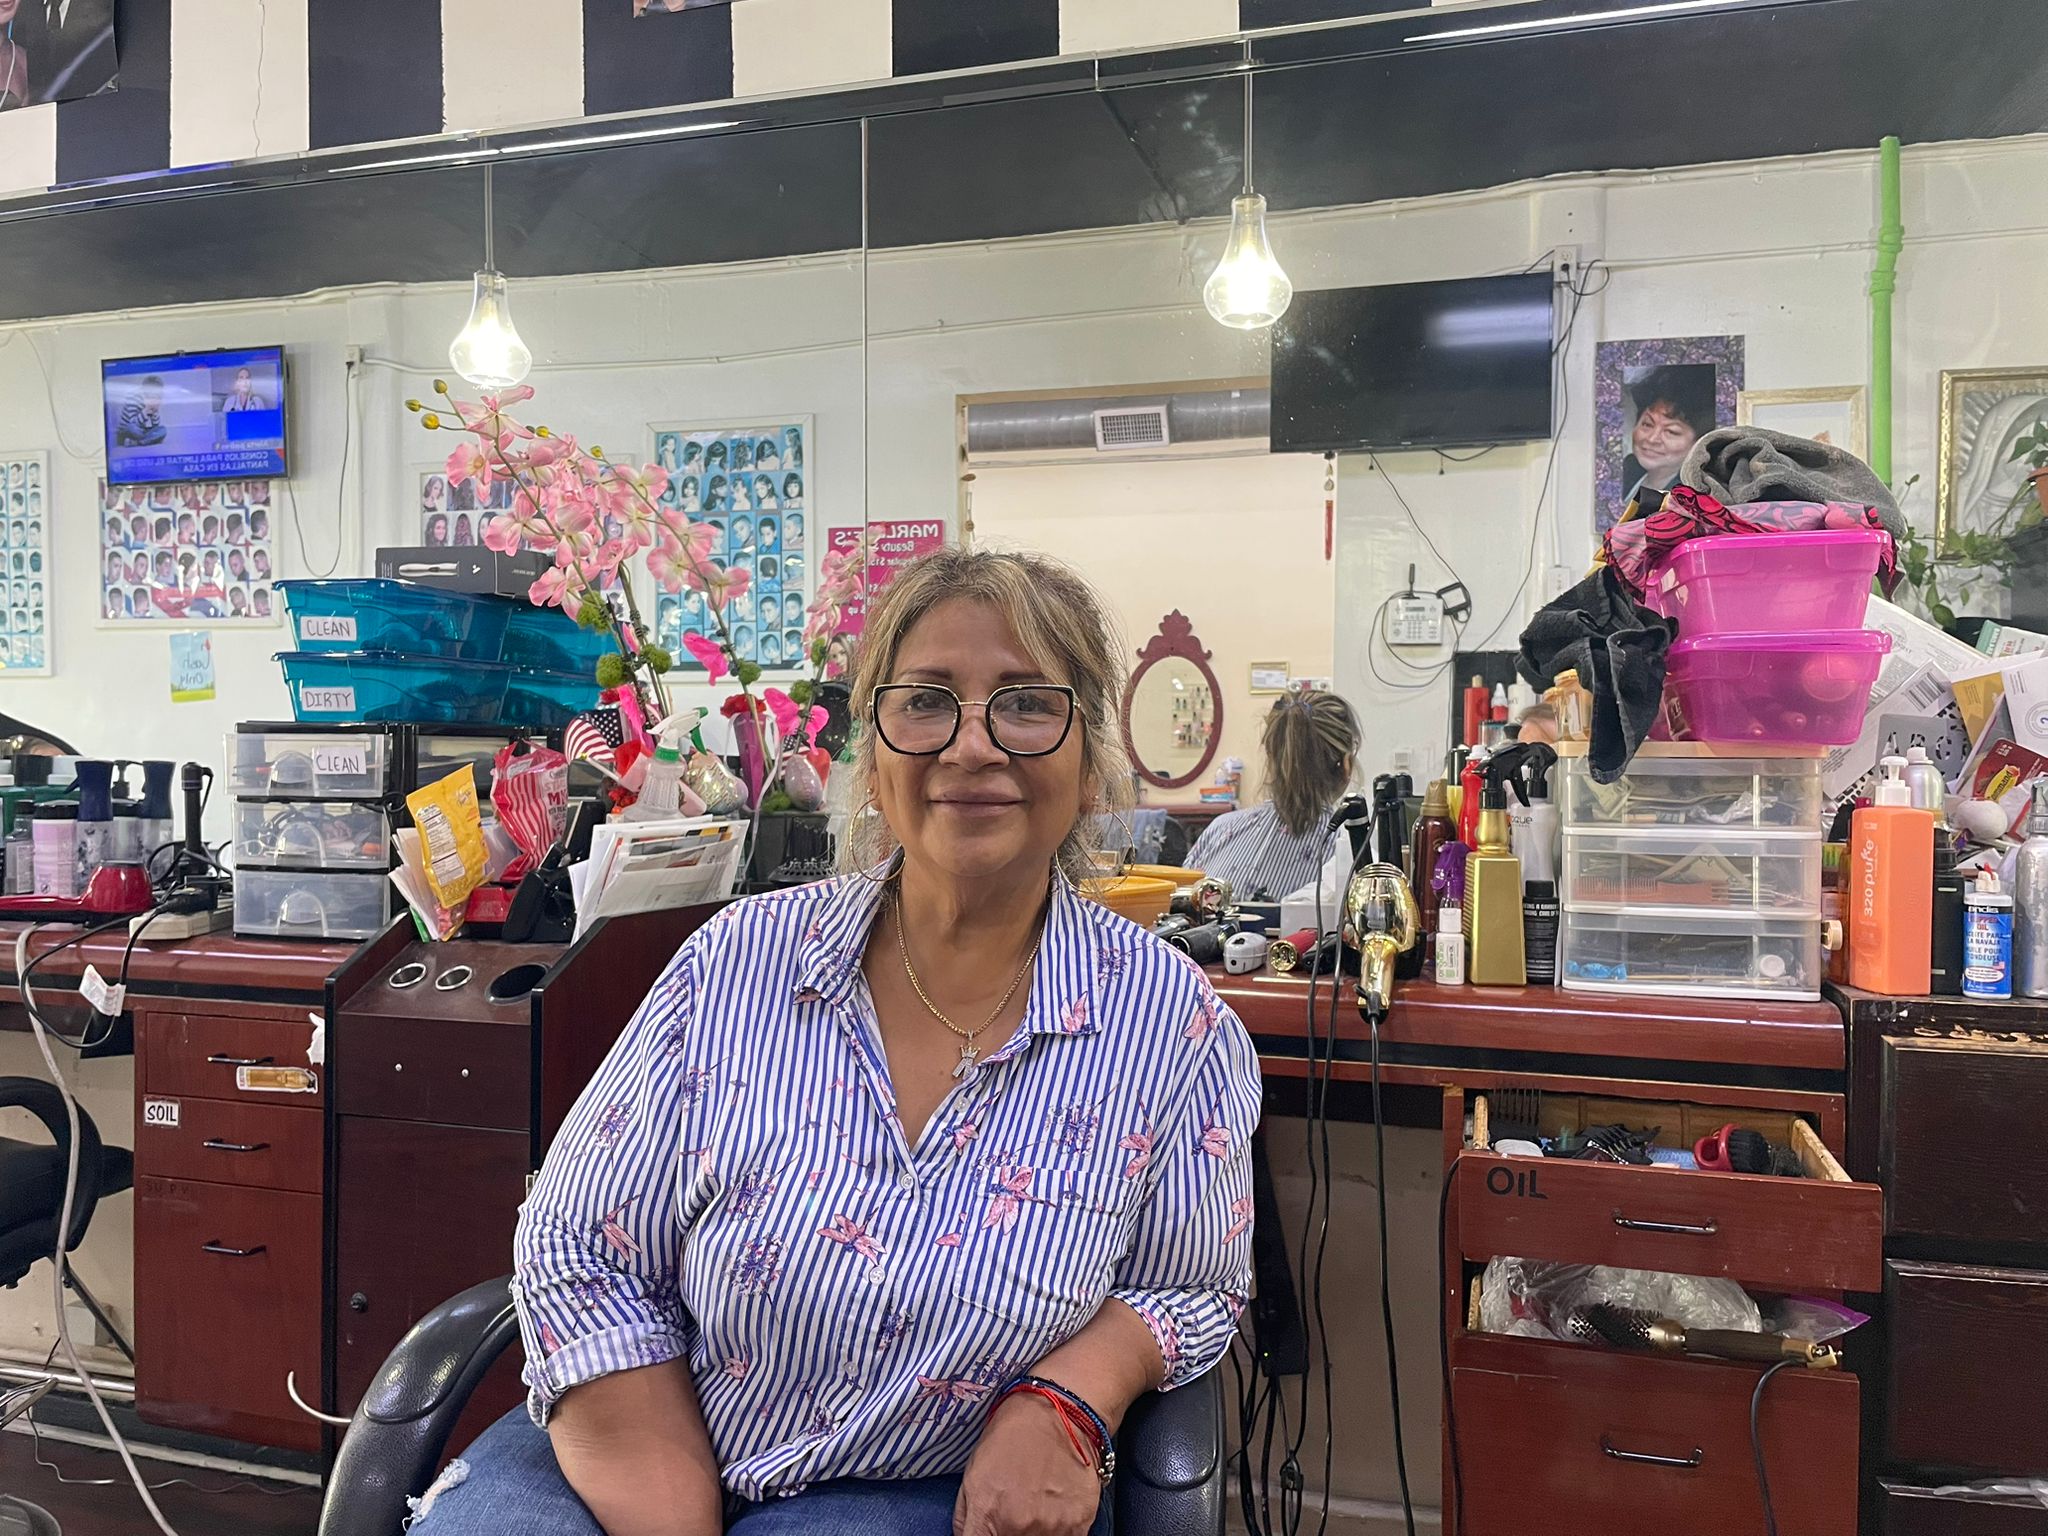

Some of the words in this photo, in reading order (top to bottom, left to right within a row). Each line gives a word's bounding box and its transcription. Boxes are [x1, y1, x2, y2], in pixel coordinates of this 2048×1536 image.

[306, 619, 351, 637] CLEAN
[304, 691, 352, 708] DIRTY
[315, 754, 359, 773] CLEAN
[1976, 923, 1989, 931] OIL
[147, 1105, 177, 1122] SOIL
[1487, 1166, 1548, 1199] OIL
